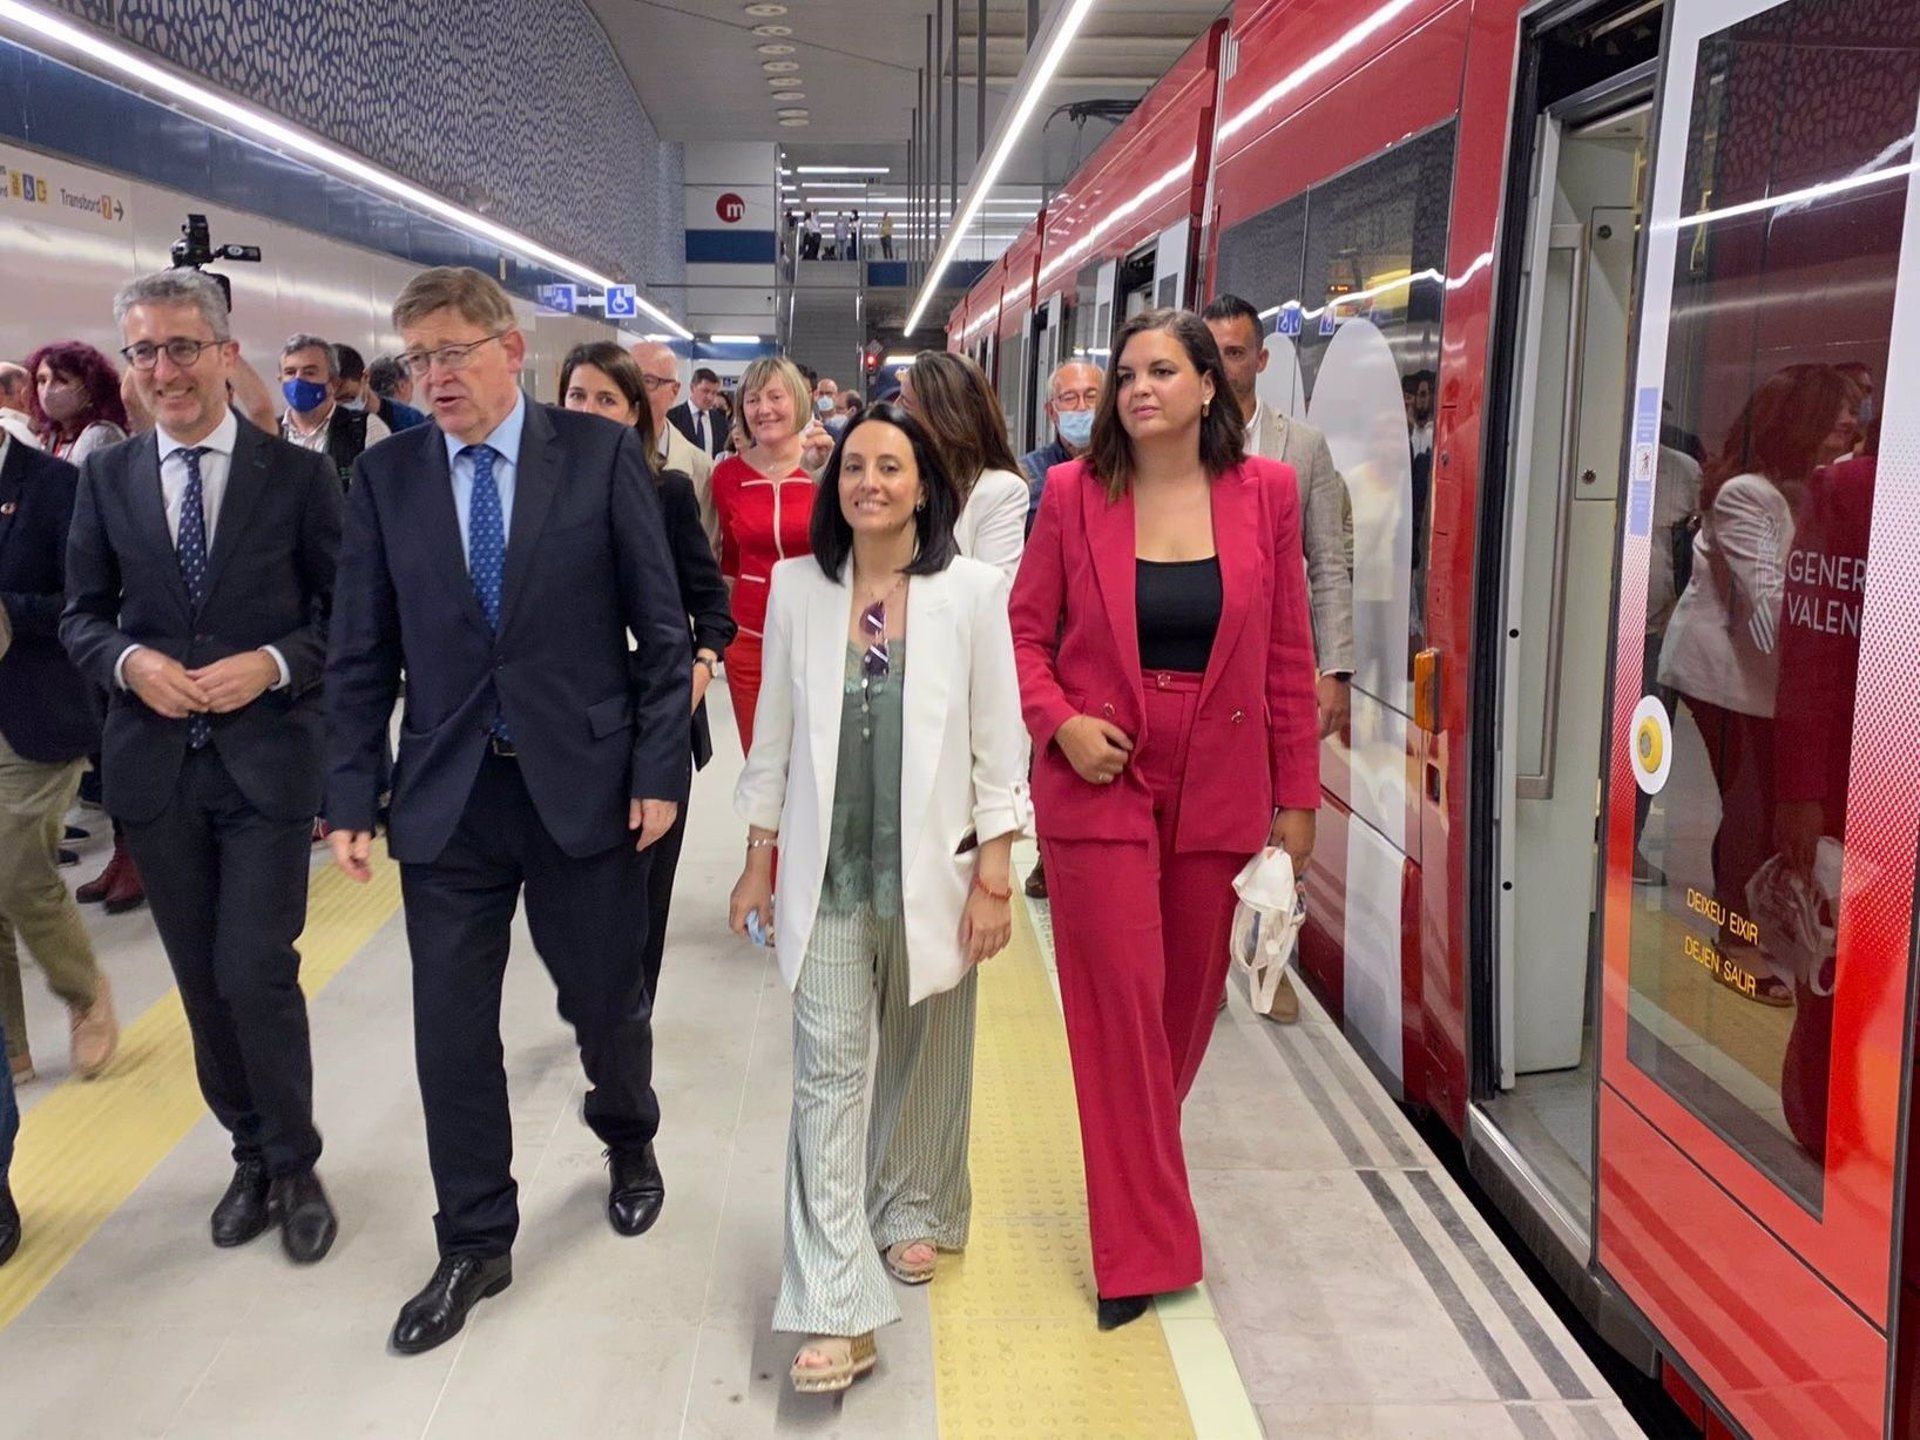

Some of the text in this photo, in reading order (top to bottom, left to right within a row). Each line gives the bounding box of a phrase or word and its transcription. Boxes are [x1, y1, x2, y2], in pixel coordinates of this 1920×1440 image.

[60, 188, 101, 213] Transbord
[1787, 550, 1867, 593] GENER
[1787, 592, 1860, 638] VALEN
[1687, 888, 1758, 945] DEIXEU EIXIR
[1684, 935, 1756, 998] DEJEN SALIR
